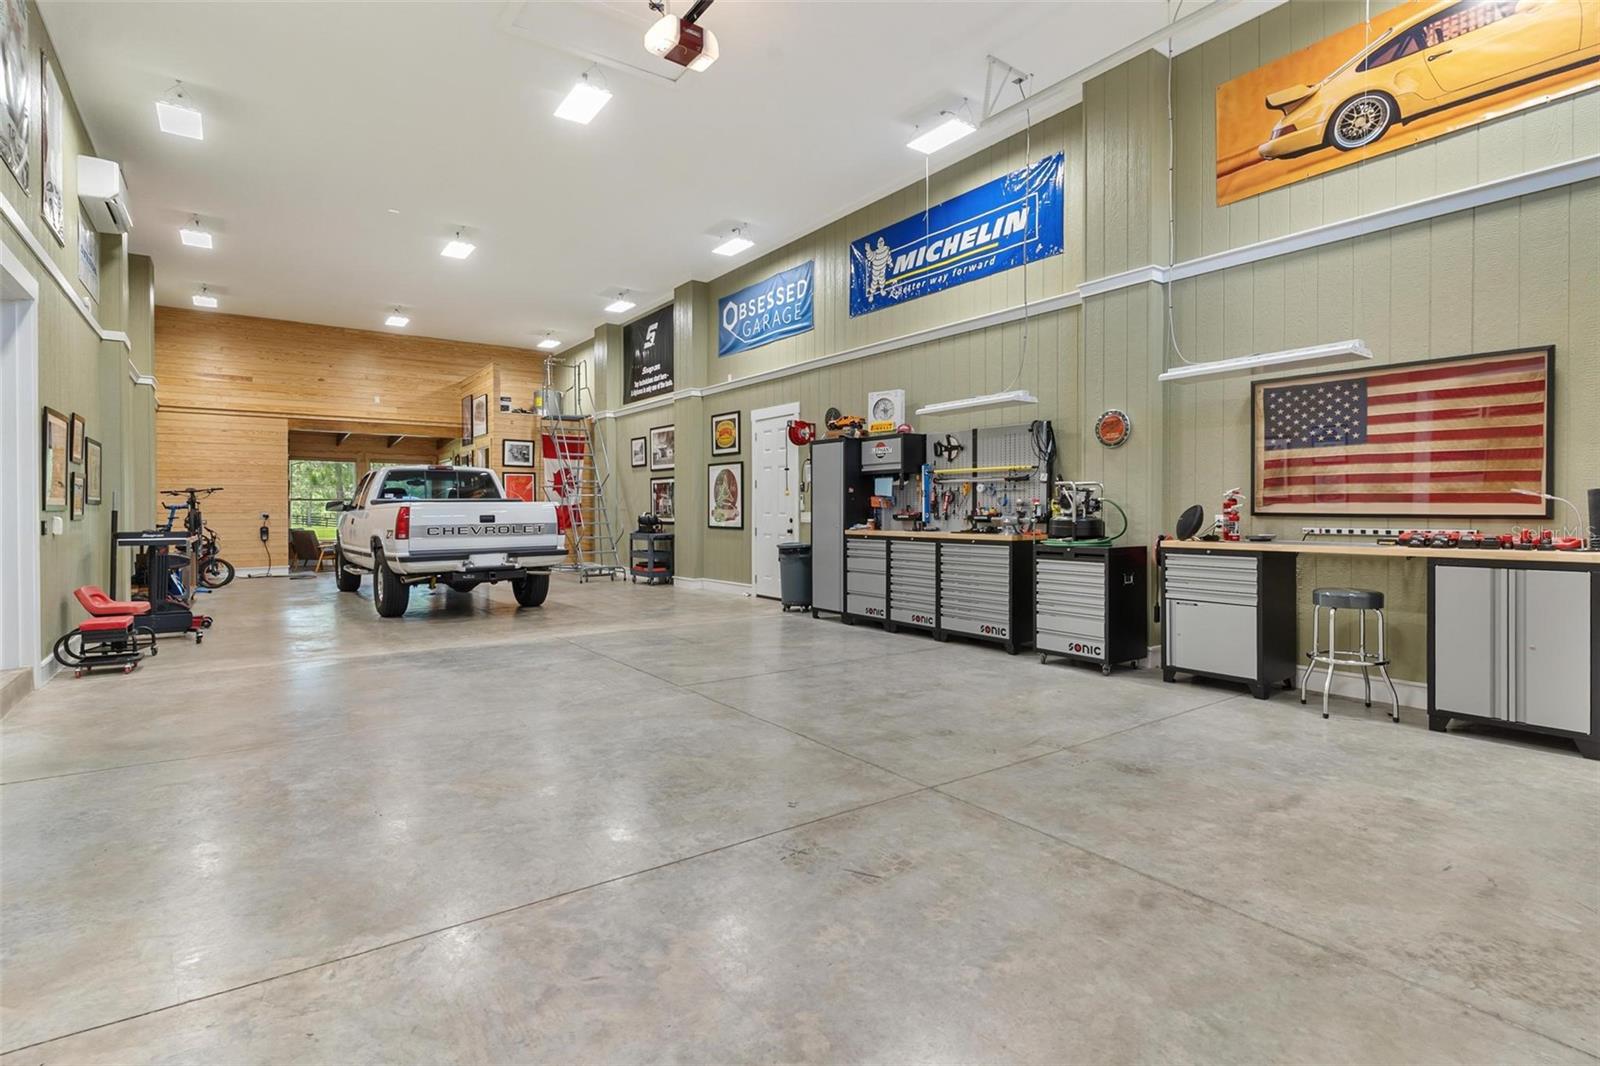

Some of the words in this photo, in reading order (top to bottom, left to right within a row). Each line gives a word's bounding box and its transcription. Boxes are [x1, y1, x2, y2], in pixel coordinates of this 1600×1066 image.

[893, 205, 1030, 275] MICHELIN
[929, 273, 949, 284] way
[952, 255, 996, 277] forward
[723, 279, 807, 331] OBSESSED
[742, 302, 802, 337] GARAGE
[426, 524, 545, 536] CHEVROLET
